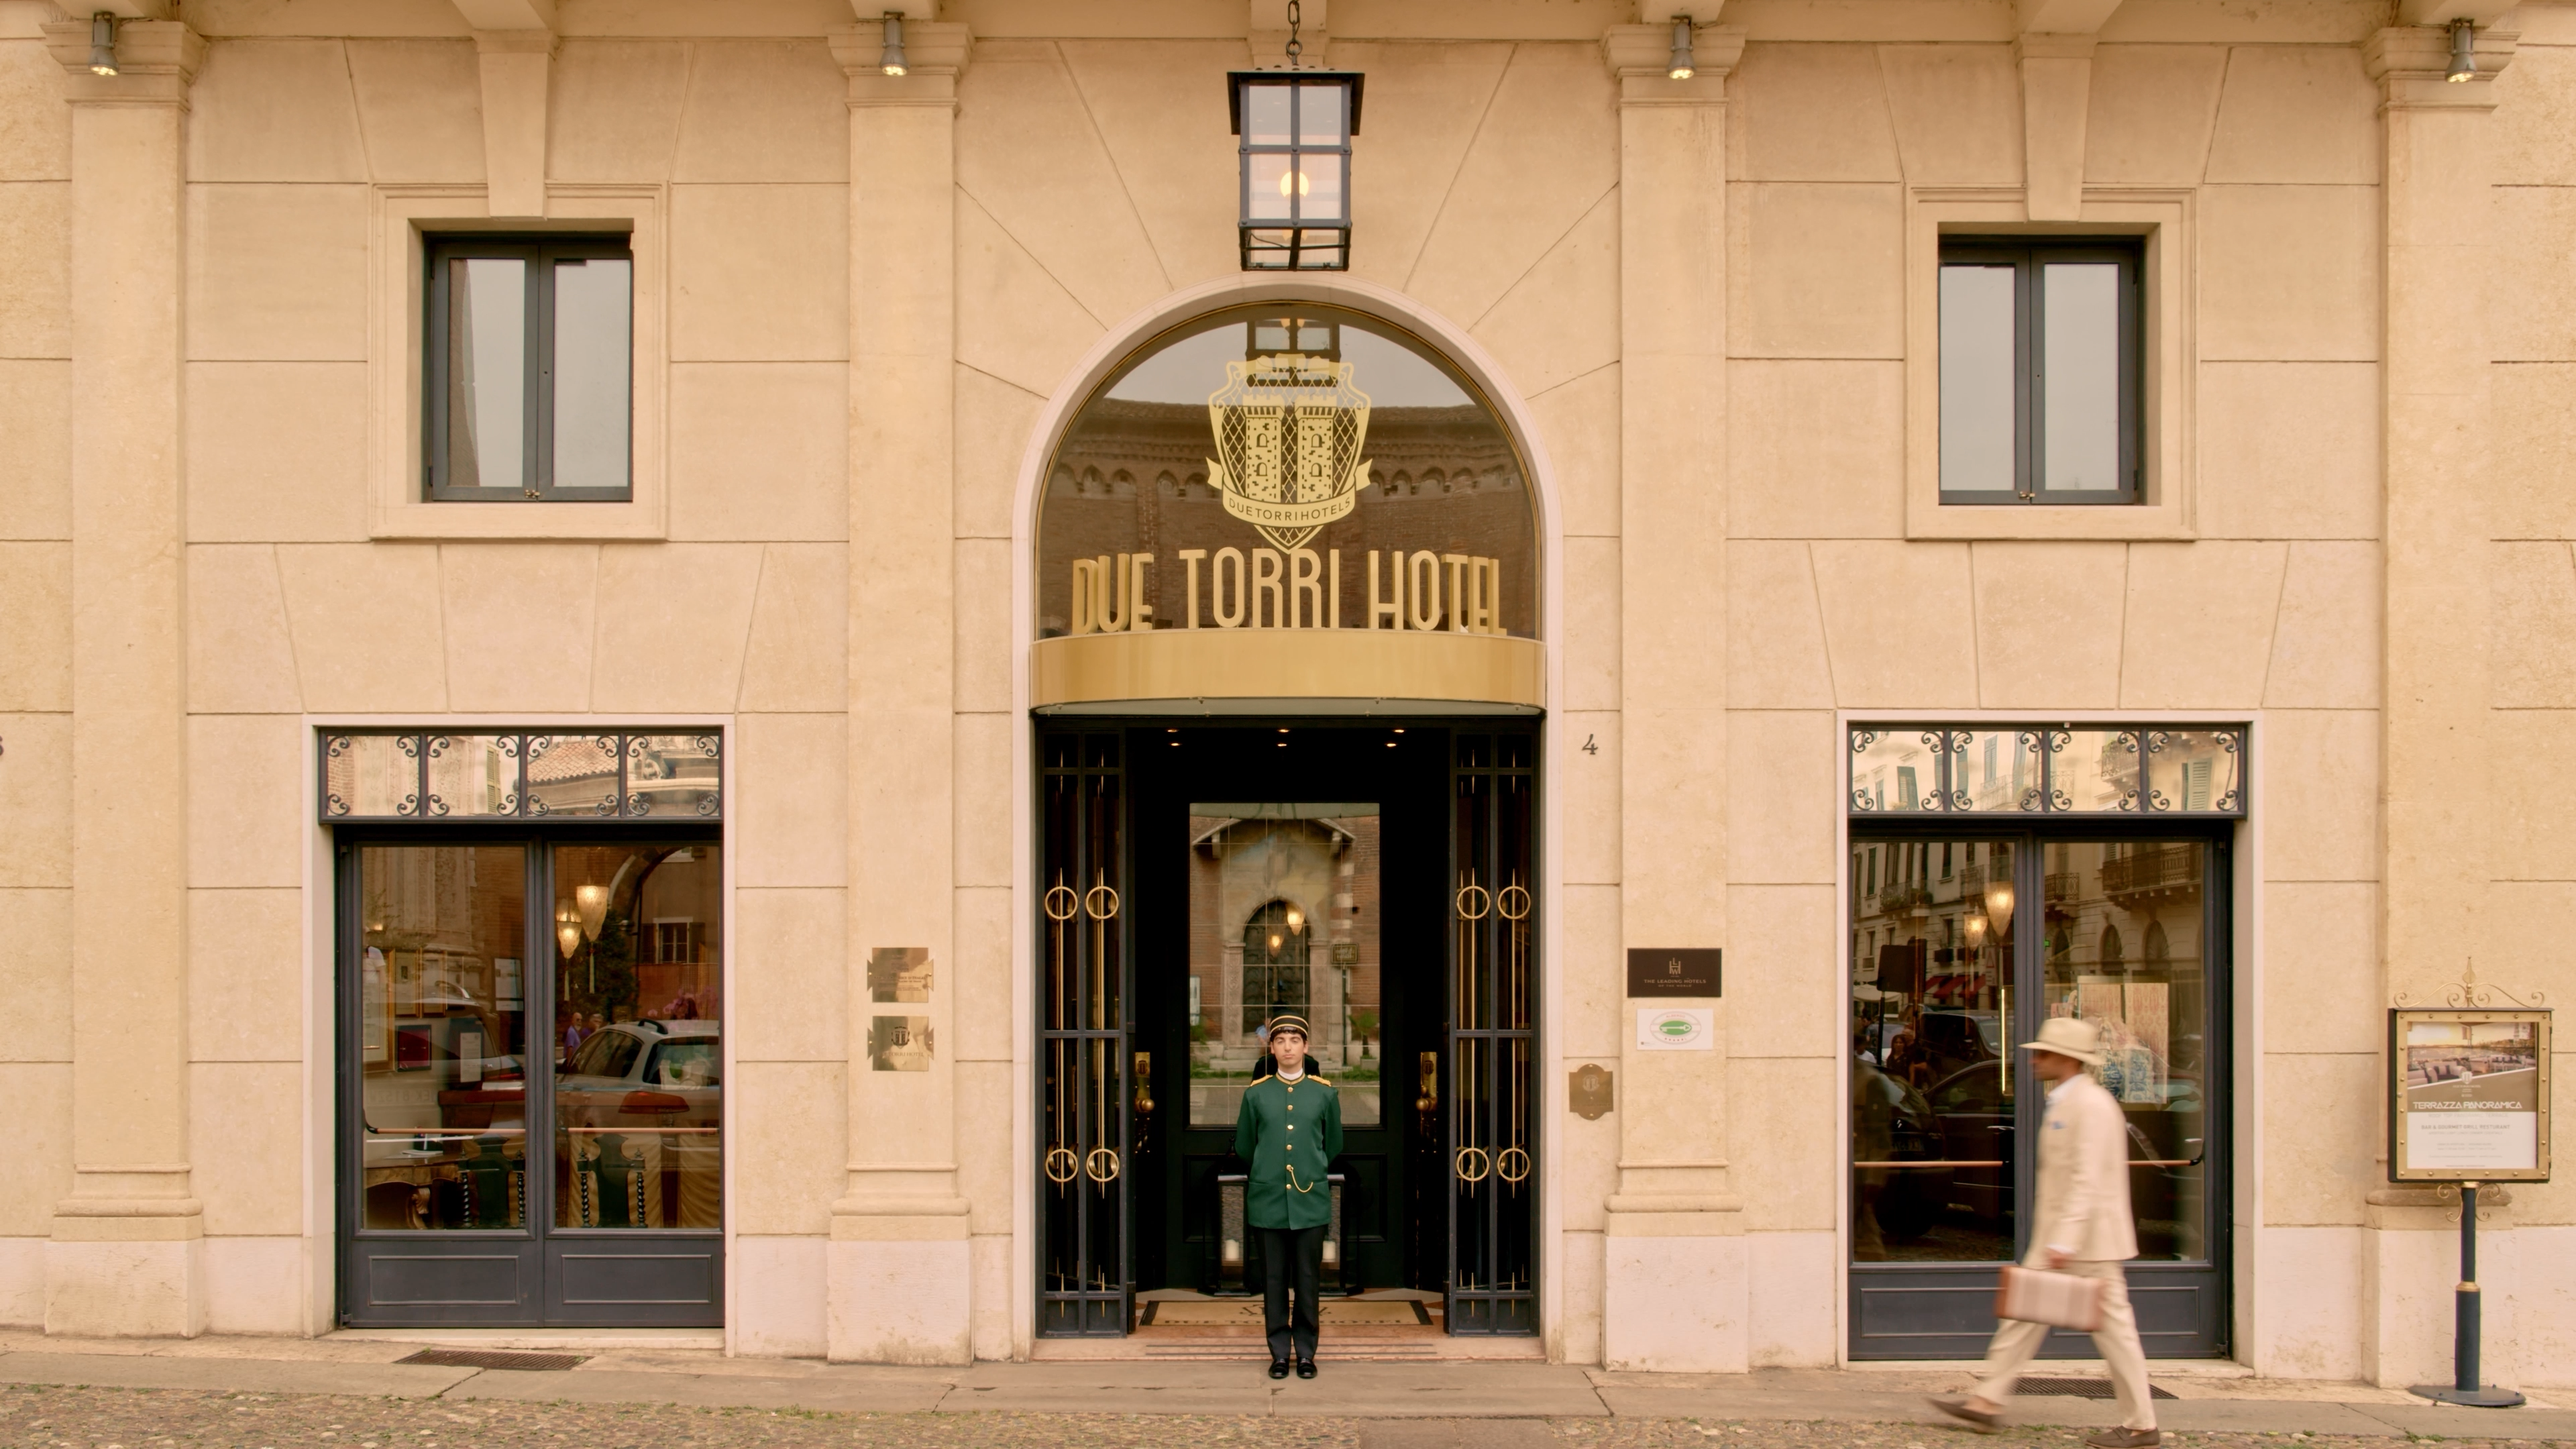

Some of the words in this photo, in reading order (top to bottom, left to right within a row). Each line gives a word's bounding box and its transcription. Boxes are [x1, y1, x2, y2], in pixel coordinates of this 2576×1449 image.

[1229, 496, 1350, 521] DUETORRIHOTELS
[1072, 553, 1154, 635] DUE
[1179, 547, 1340, 629] TORRI
[1368, 550, 1507, 636] HOTEL
[1582, 733, 1599, 755] 4
